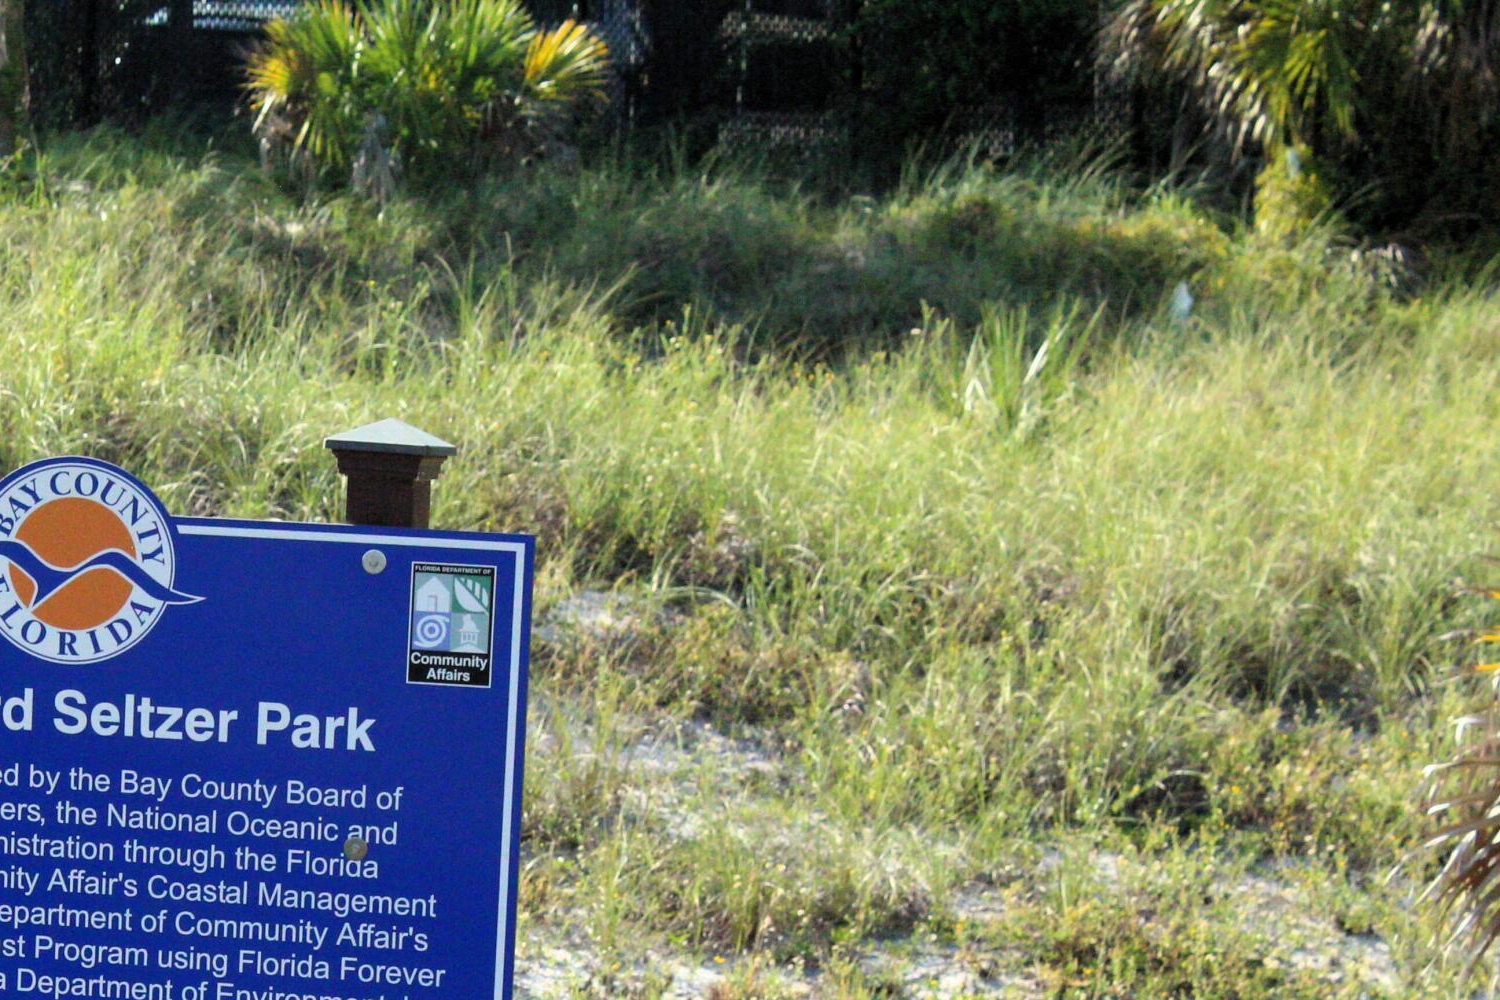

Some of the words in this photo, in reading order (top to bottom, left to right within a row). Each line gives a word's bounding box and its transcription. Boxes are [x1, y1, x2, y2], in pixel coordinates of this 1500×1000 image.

[49, 470, 166, 566] COUNTY
[410, 651, 488, 671] Community
[426, 667, 471, 682] Affairs
[53, 688, 239, 743] Seltzer
[256, 701, 377, 752] Park
[29, 763, 61, 795] by
[68, 766, 111, 793] the
[120, 769, 173, 802] Bay
[181, 773, 278, 809] County
[286, 779, 367, 809] Board
[375, 786, 405, 811] of
[55, 800, 98, 826] the
[107, 802, 217, 834] National
[226, 810, 339, 842] Oceanic
[345, 821, 398, 849] and
[122, 838, 226, 874] through
[234, 846, 277, 872] the
[287, 848, 379, 879] Florida
[46, 867, 138, 898] Affair's
[147, 874, 248, 905] Coastal
[258, 881, 437, 918] Management
[140, 909, 168, 934] of
[174, 910, 329, 951] Community
[335, 922, 429, 952] Affair's
[34, 934, 149, 969] Program
[157, 945, 228, 979] using
[238, 949, 330, 980] Florida
[340, 956, 447, 988] Forever
